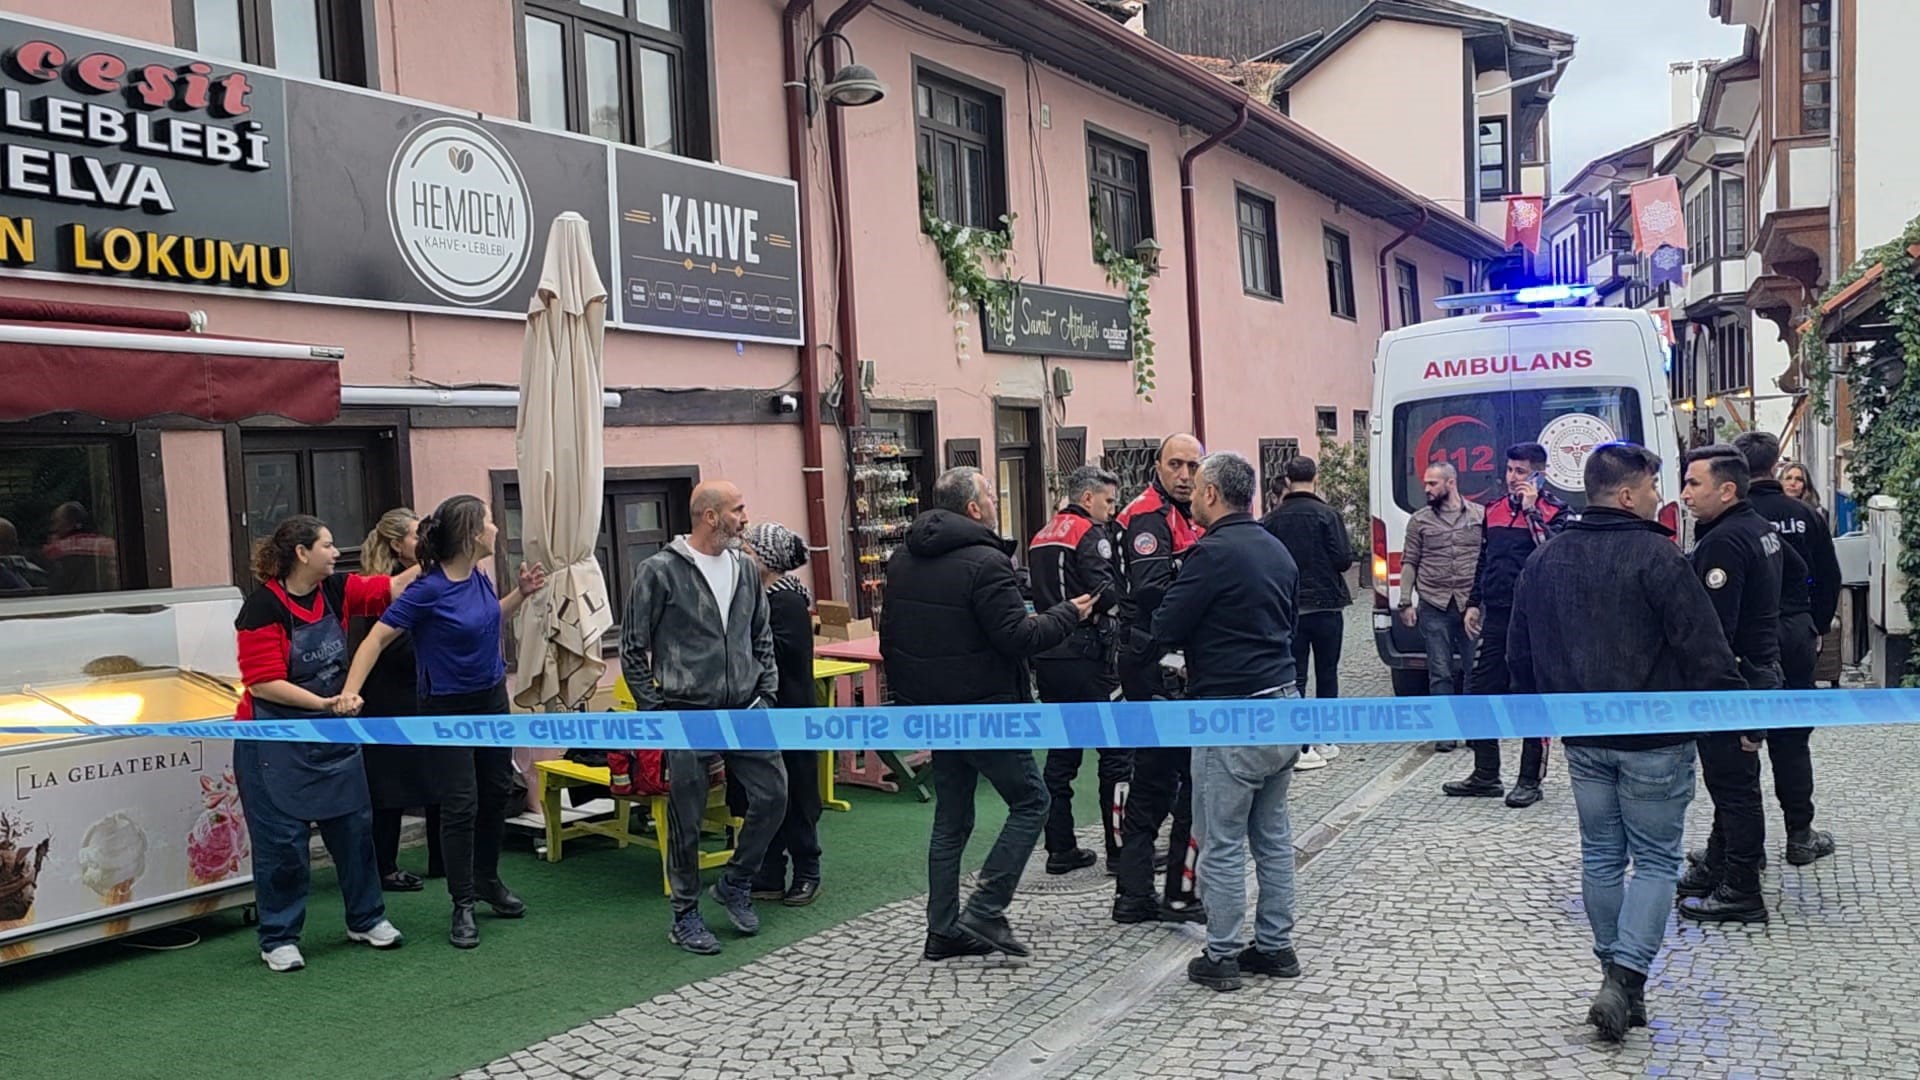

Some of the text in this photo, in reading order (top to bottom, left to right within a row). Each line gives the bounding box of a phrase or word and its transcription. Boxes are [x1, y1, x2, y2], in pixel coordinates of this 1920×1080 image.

[5, 90, 271, 168] LEBLEBİ
[0, 145, 175, 211] ELVA
[412, 180, 516, 241] HEMDEM
[662, 193, 761, 264] KAHVE
[73, 223, 291, 287] LOKUMU
[424, 235, 460, 252] KAHVE
[1021, 297, 1056, 336] Sanat
[1423, 350, 1593, 380] AMBULANS
[1429, 445, 1495, 472] 112
[30, 750, 192, 790] LA GELATERIA
